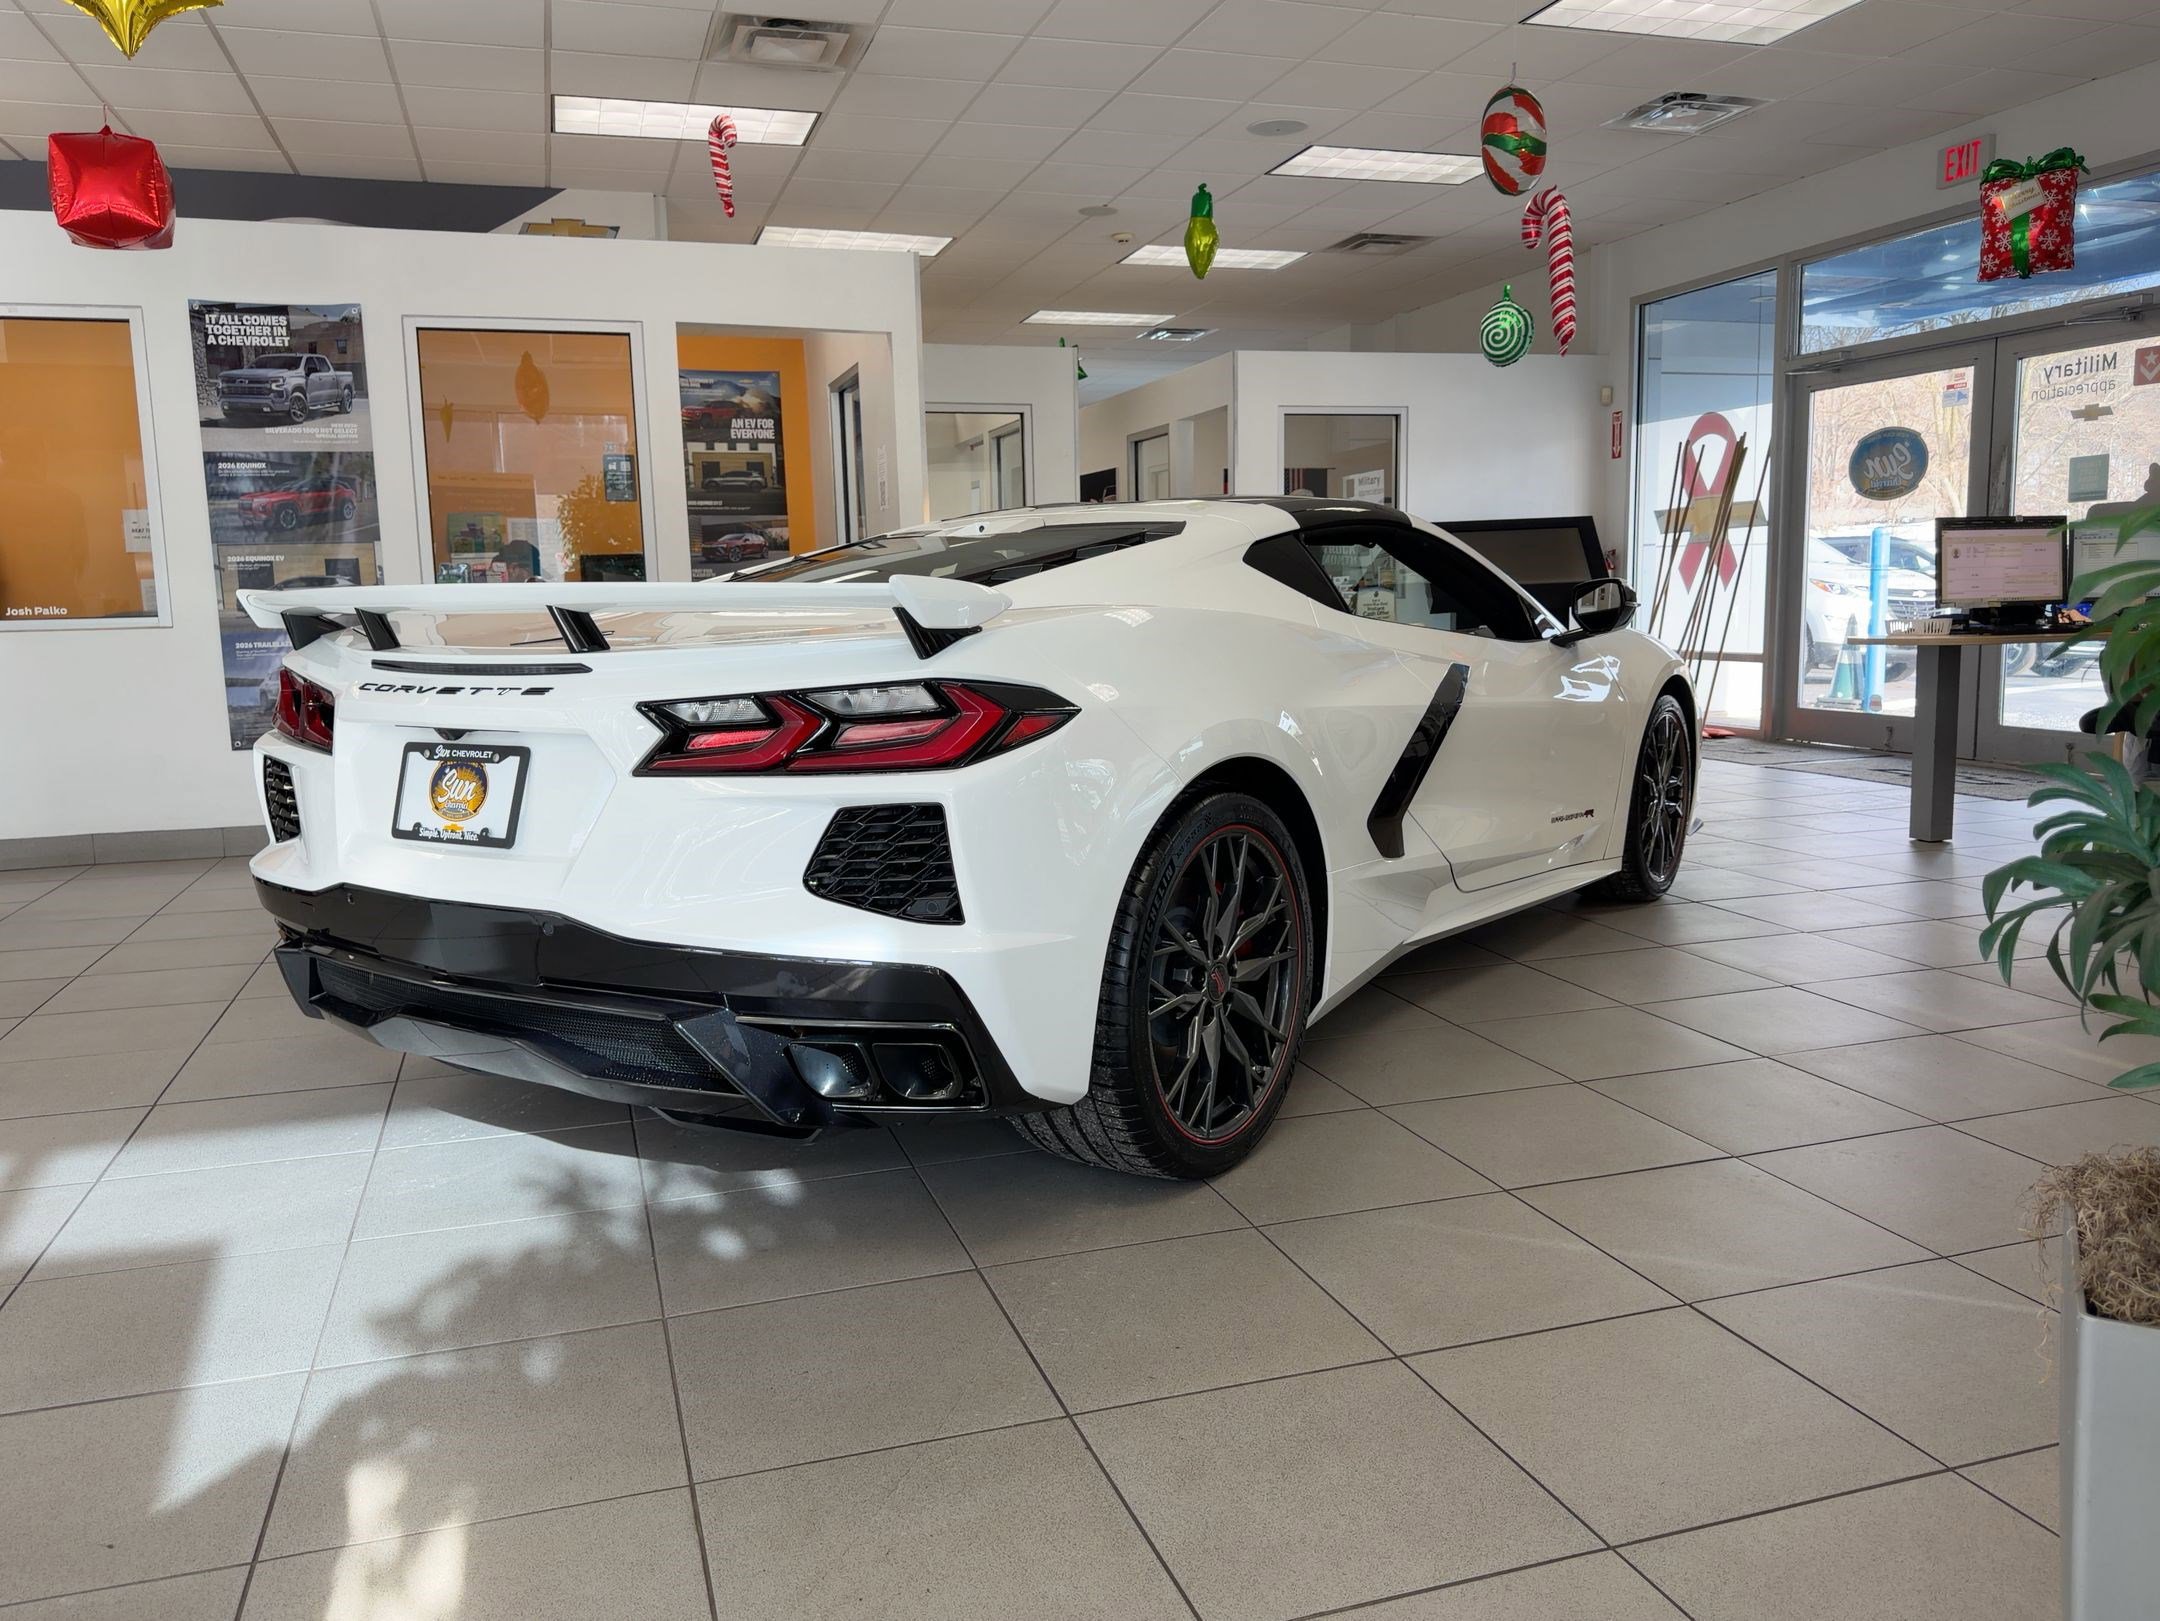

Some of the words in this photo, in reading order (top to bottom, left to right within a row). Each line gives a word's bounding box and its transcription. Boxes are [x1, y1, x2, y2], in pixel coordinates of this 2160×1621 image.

[1945, 139, 1981, 182] EXIT
[205, 314, 218, 324] IT
[218, 315, 242, 325] ALL
[242, 315, 288, 326] COMES
[205, 325, 271, 336] TOGETHER
[273, 326, 287, 336] IN
[207, 336, 218, 346] A
[220, 336, 290, 347] CHEVROLET
[731, 418, 744, 428] AN
[745, 418, 756, 428] EV
[757, 418, 774, 429] FOR
[730, 428, 775, 439] EVERYONE
[5, 606, 33, 616] Josh
[34, 606, 68, 616] Palko
[358, 682, 555, 696] CORVETTE
[433, 744, 451, 760] Sun
[451, 750, 494, 759] CHEVROLET
[437, 768, 477, 804] Sun
[1141, 863, 1175, 961] MICHELIN
